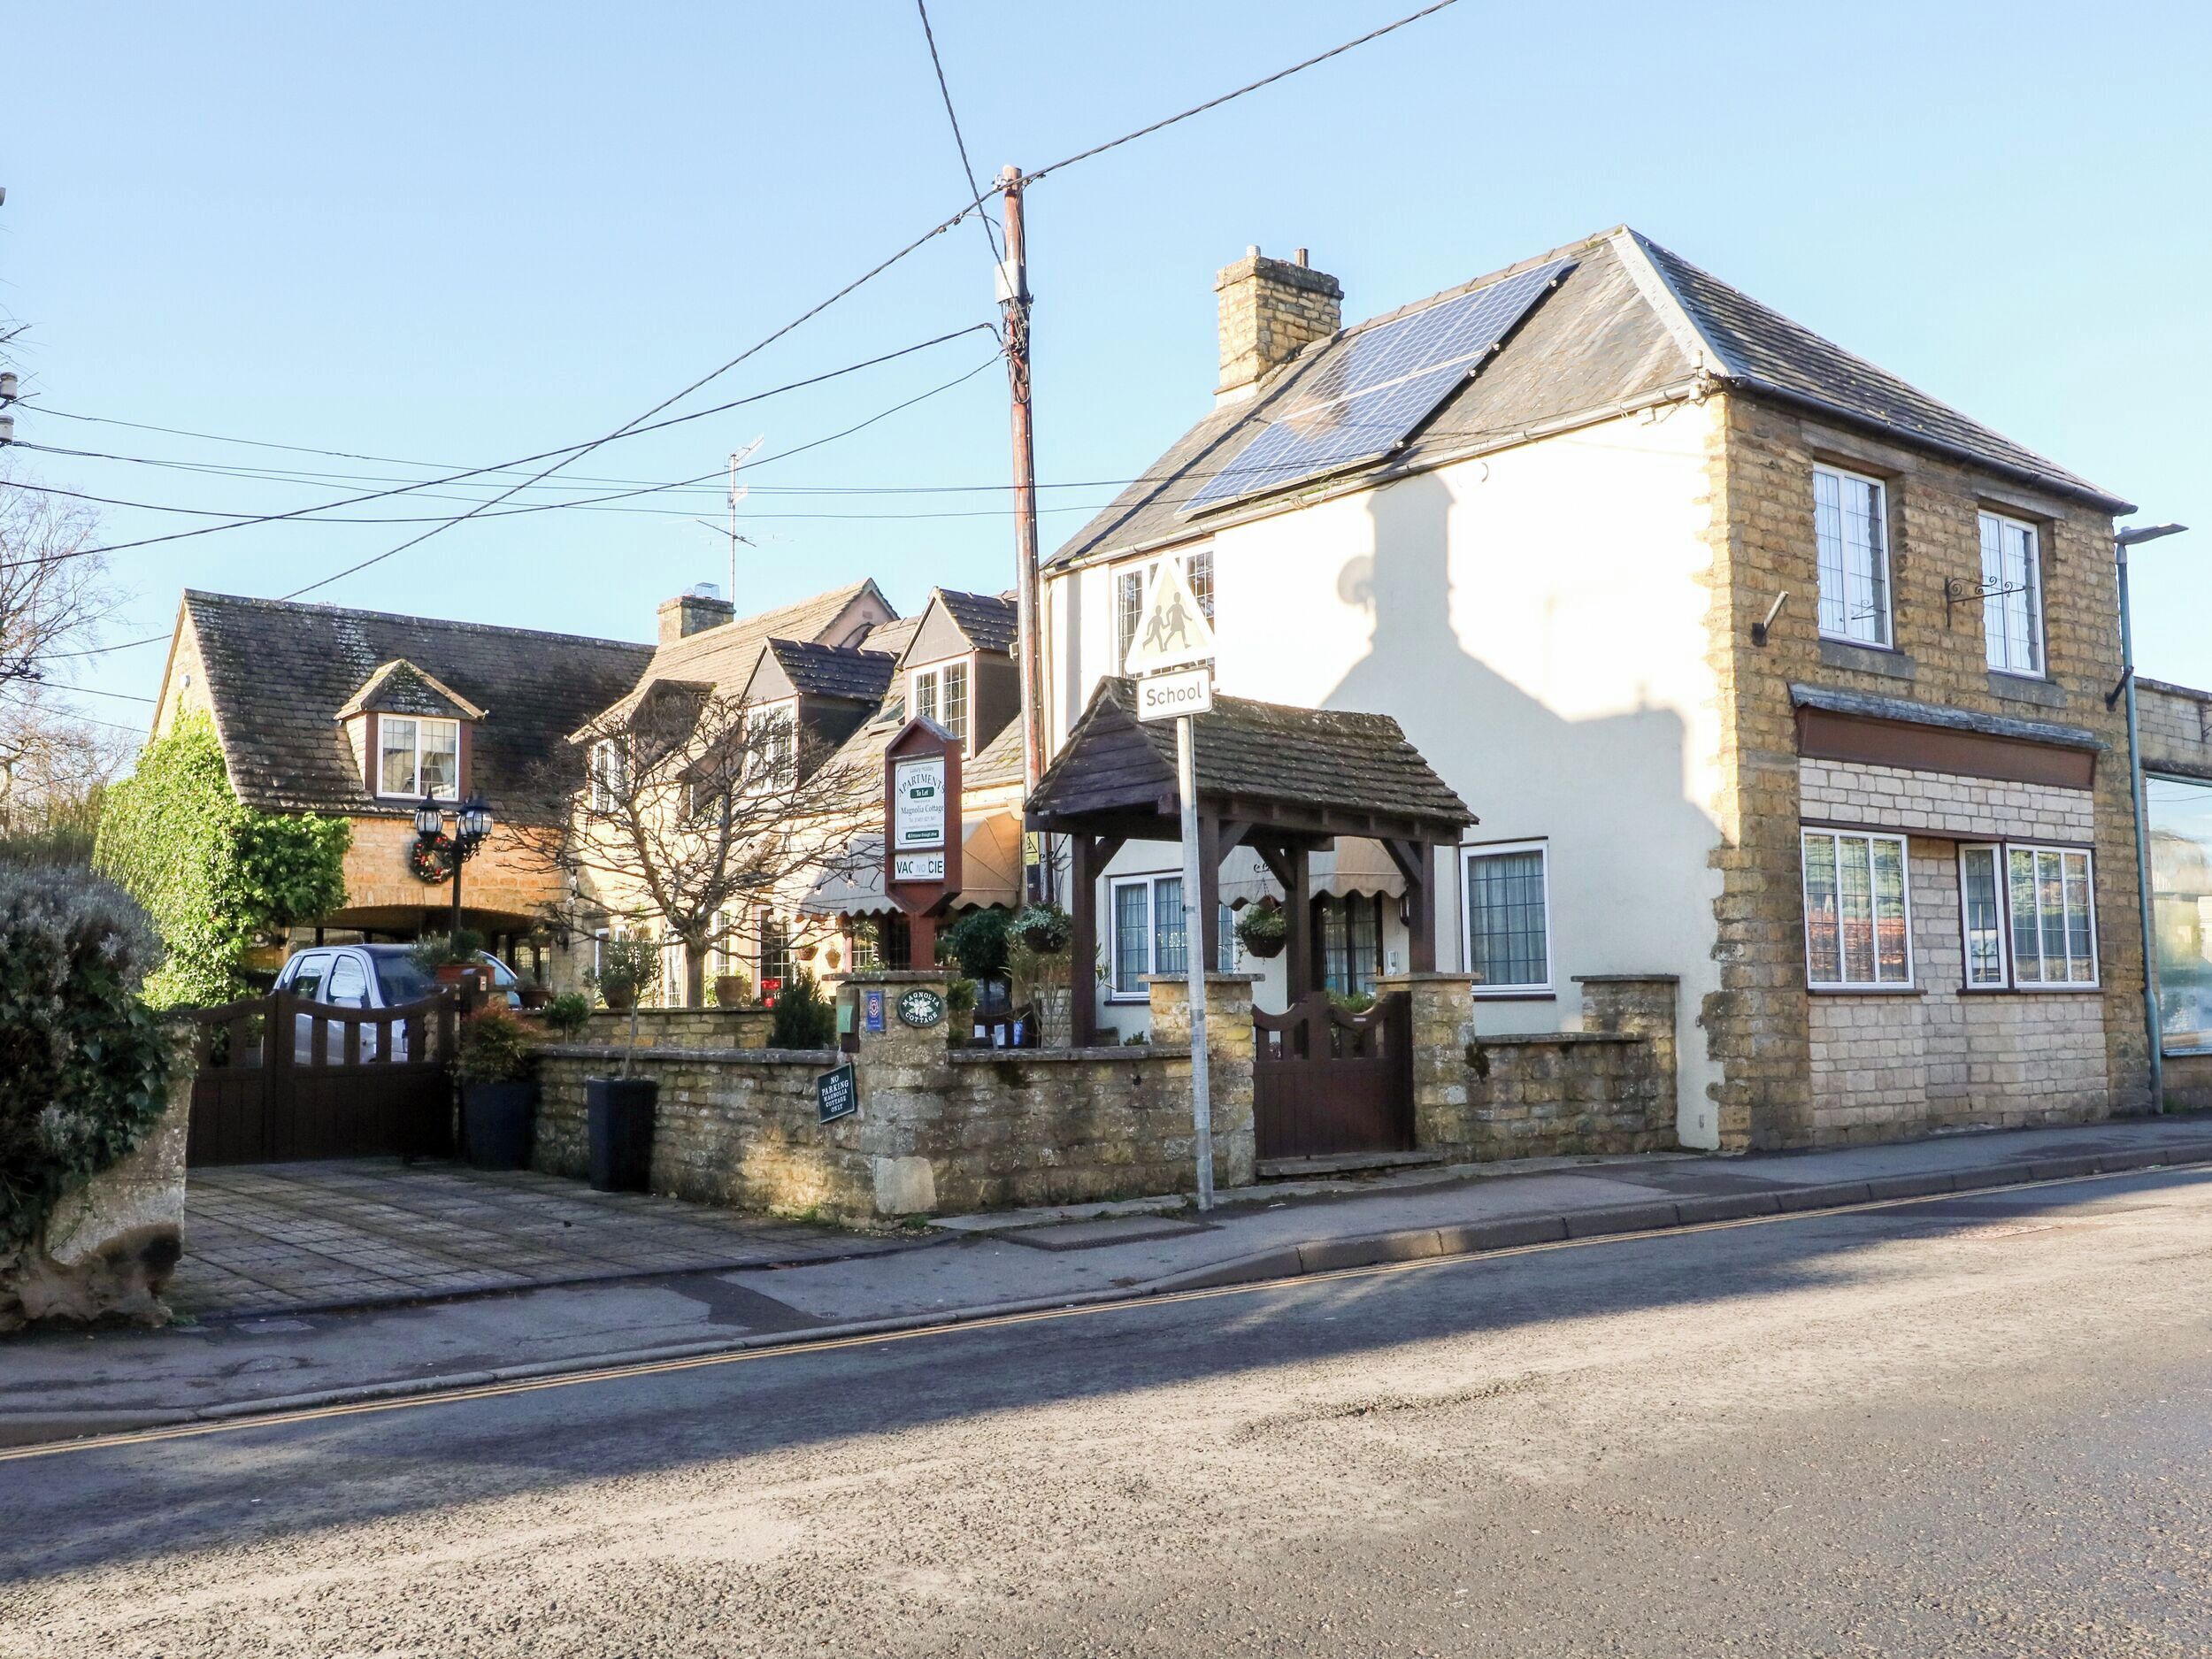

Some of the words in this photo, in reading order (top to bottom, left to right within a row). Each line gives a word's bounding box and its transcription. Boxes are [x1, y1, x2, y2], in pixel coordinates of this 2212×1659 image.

[1147, 681, 1202, 706] School
[899, 773, 945, 797] APARTMENTS
[901, 805, 924, 816] Magnolia
[925, 804, 944, 813] Cottage
[902, 992, 940, 1007] MAGNOLIA
[905, 1011, 938, 1024] COTTAGE
[830, 1075, 839, 1085] NO
[821, 1079, 849, 1096] PARKING
[823, 1088, 848, 1102] MAGNOLIA
[826, 1095, 847, 1108] COTTAGE
[830, 1103, 843, 1113] ONLY
